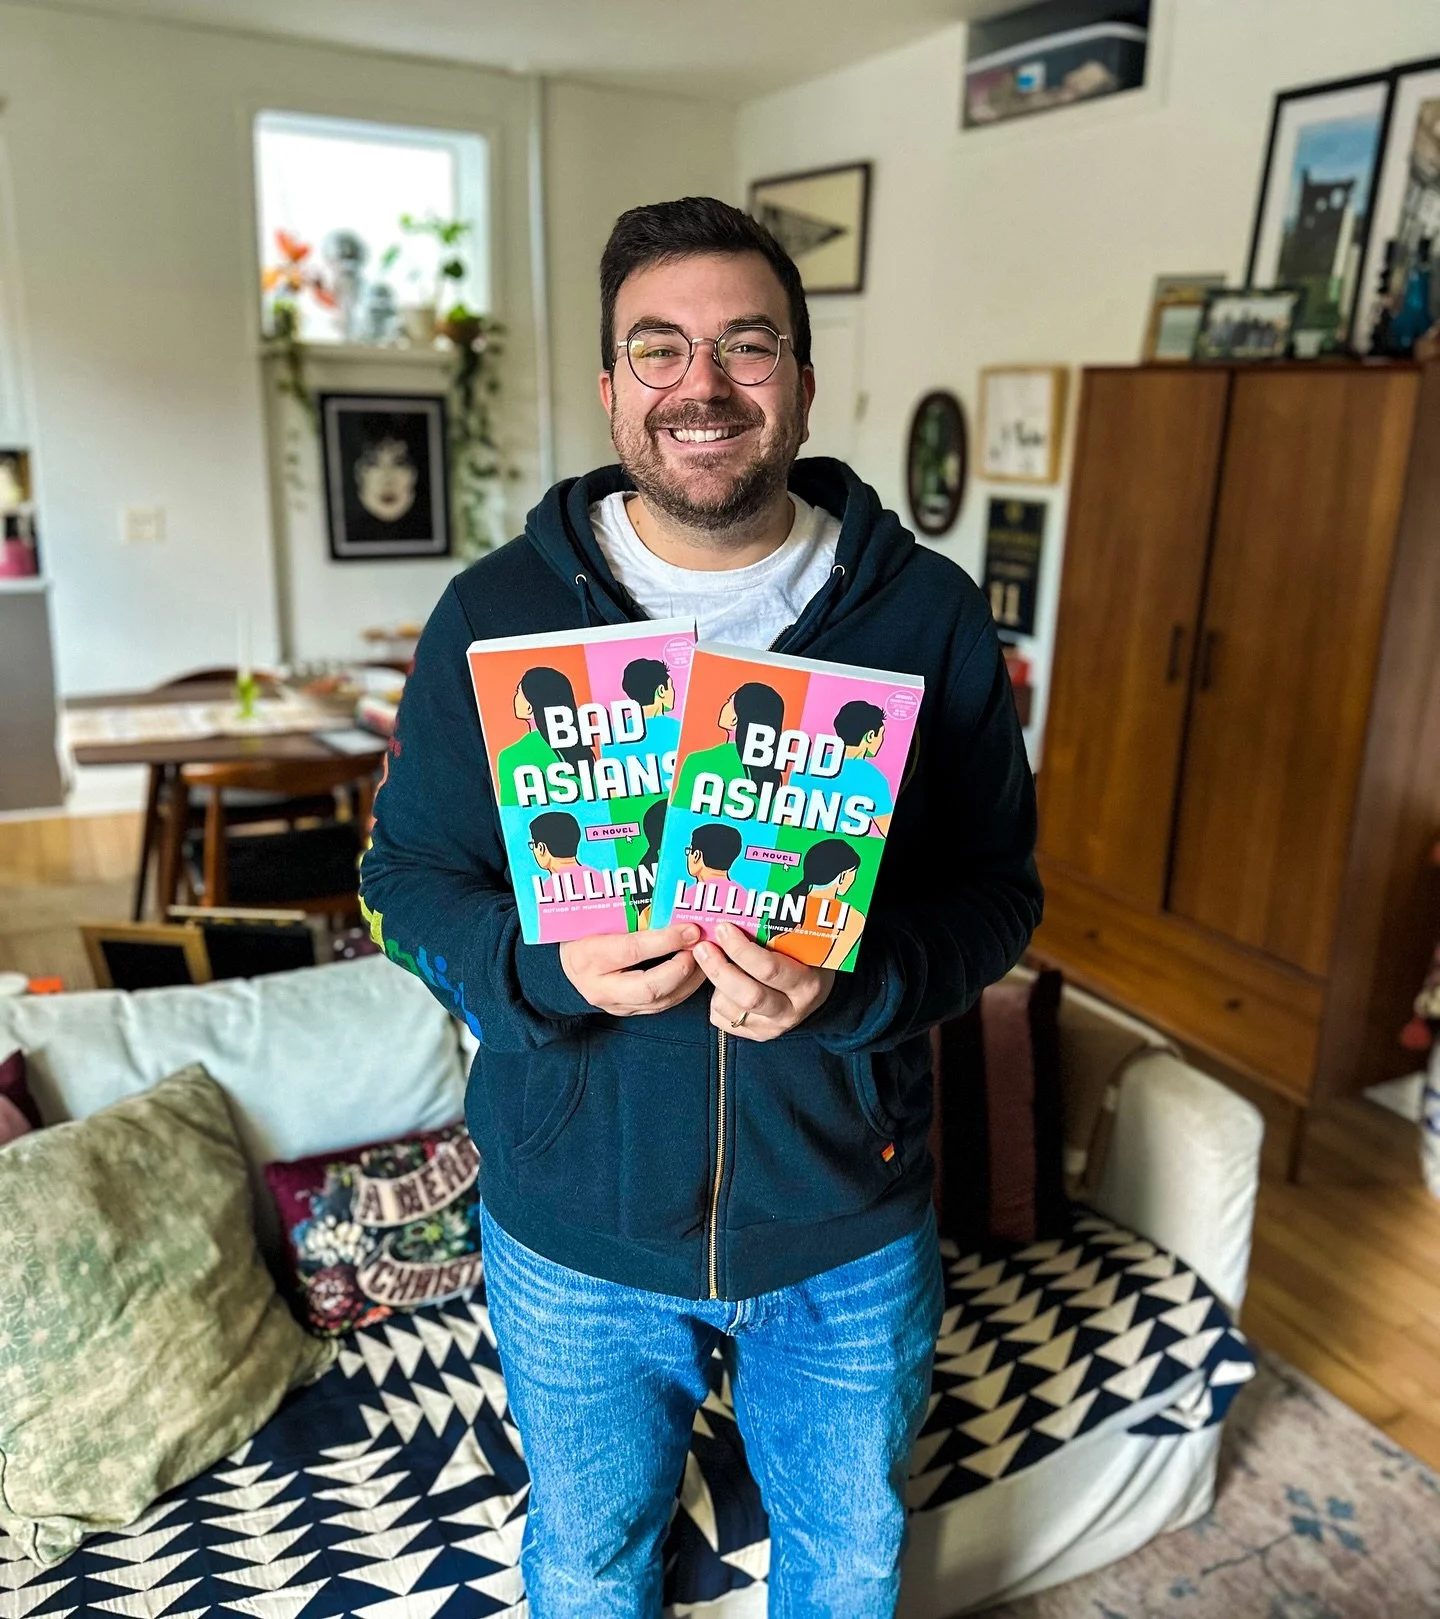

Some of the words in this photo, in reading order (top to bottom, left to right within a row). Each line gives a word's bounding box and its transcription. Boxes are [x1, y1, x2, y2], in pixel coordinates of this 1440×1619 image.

[543, 699, 647, 749] BAD
[742, 722, 845, 777] BAD
[690, 772, 875, 836] ASIANS
[602, 827, 634, 836] NOVEL
[762, 852, 794, 862] NOVEL
[532, 863, 659, 904] LILLIAN
[673, 879, 807, 924] LILLIAN
[817, 899, 850, 931] LI
[676, 913, 703, 921] AUTHOR
[763, 924, 793, 932] CHINESE
